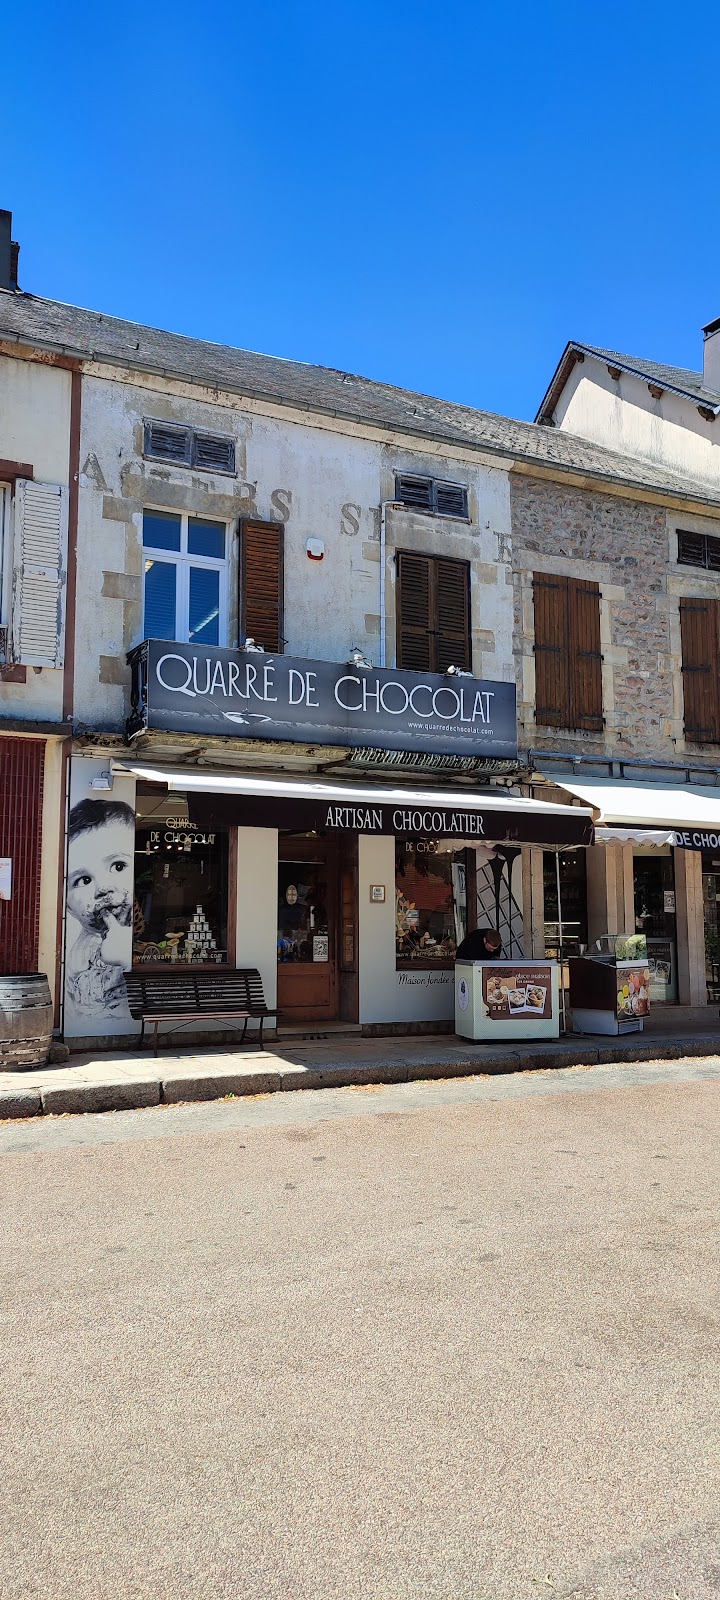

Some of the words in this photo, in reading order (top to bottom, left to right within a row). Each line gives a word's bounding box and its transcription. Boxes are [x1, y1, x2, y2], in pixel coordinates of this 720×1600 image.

[156, 654, 277, 702] QUARRÉ
[289, 669, 319, 707] DE
[334, 675, 494, 724] CHOCOLAT
[407, 721, 494, 735] www.quarredechocolat.com
[325, 806, 382, 829] ARTISAN
[393, 810, 484, 834] CHOCOLATIER
[150, 831, 160, 843] DE
[164, 831, 216, 845] CHOCOLAT
[675, 832, 692, 846] DE
[405, 841, 414, 852] DE
[416, 842, 439, 853] CHO
